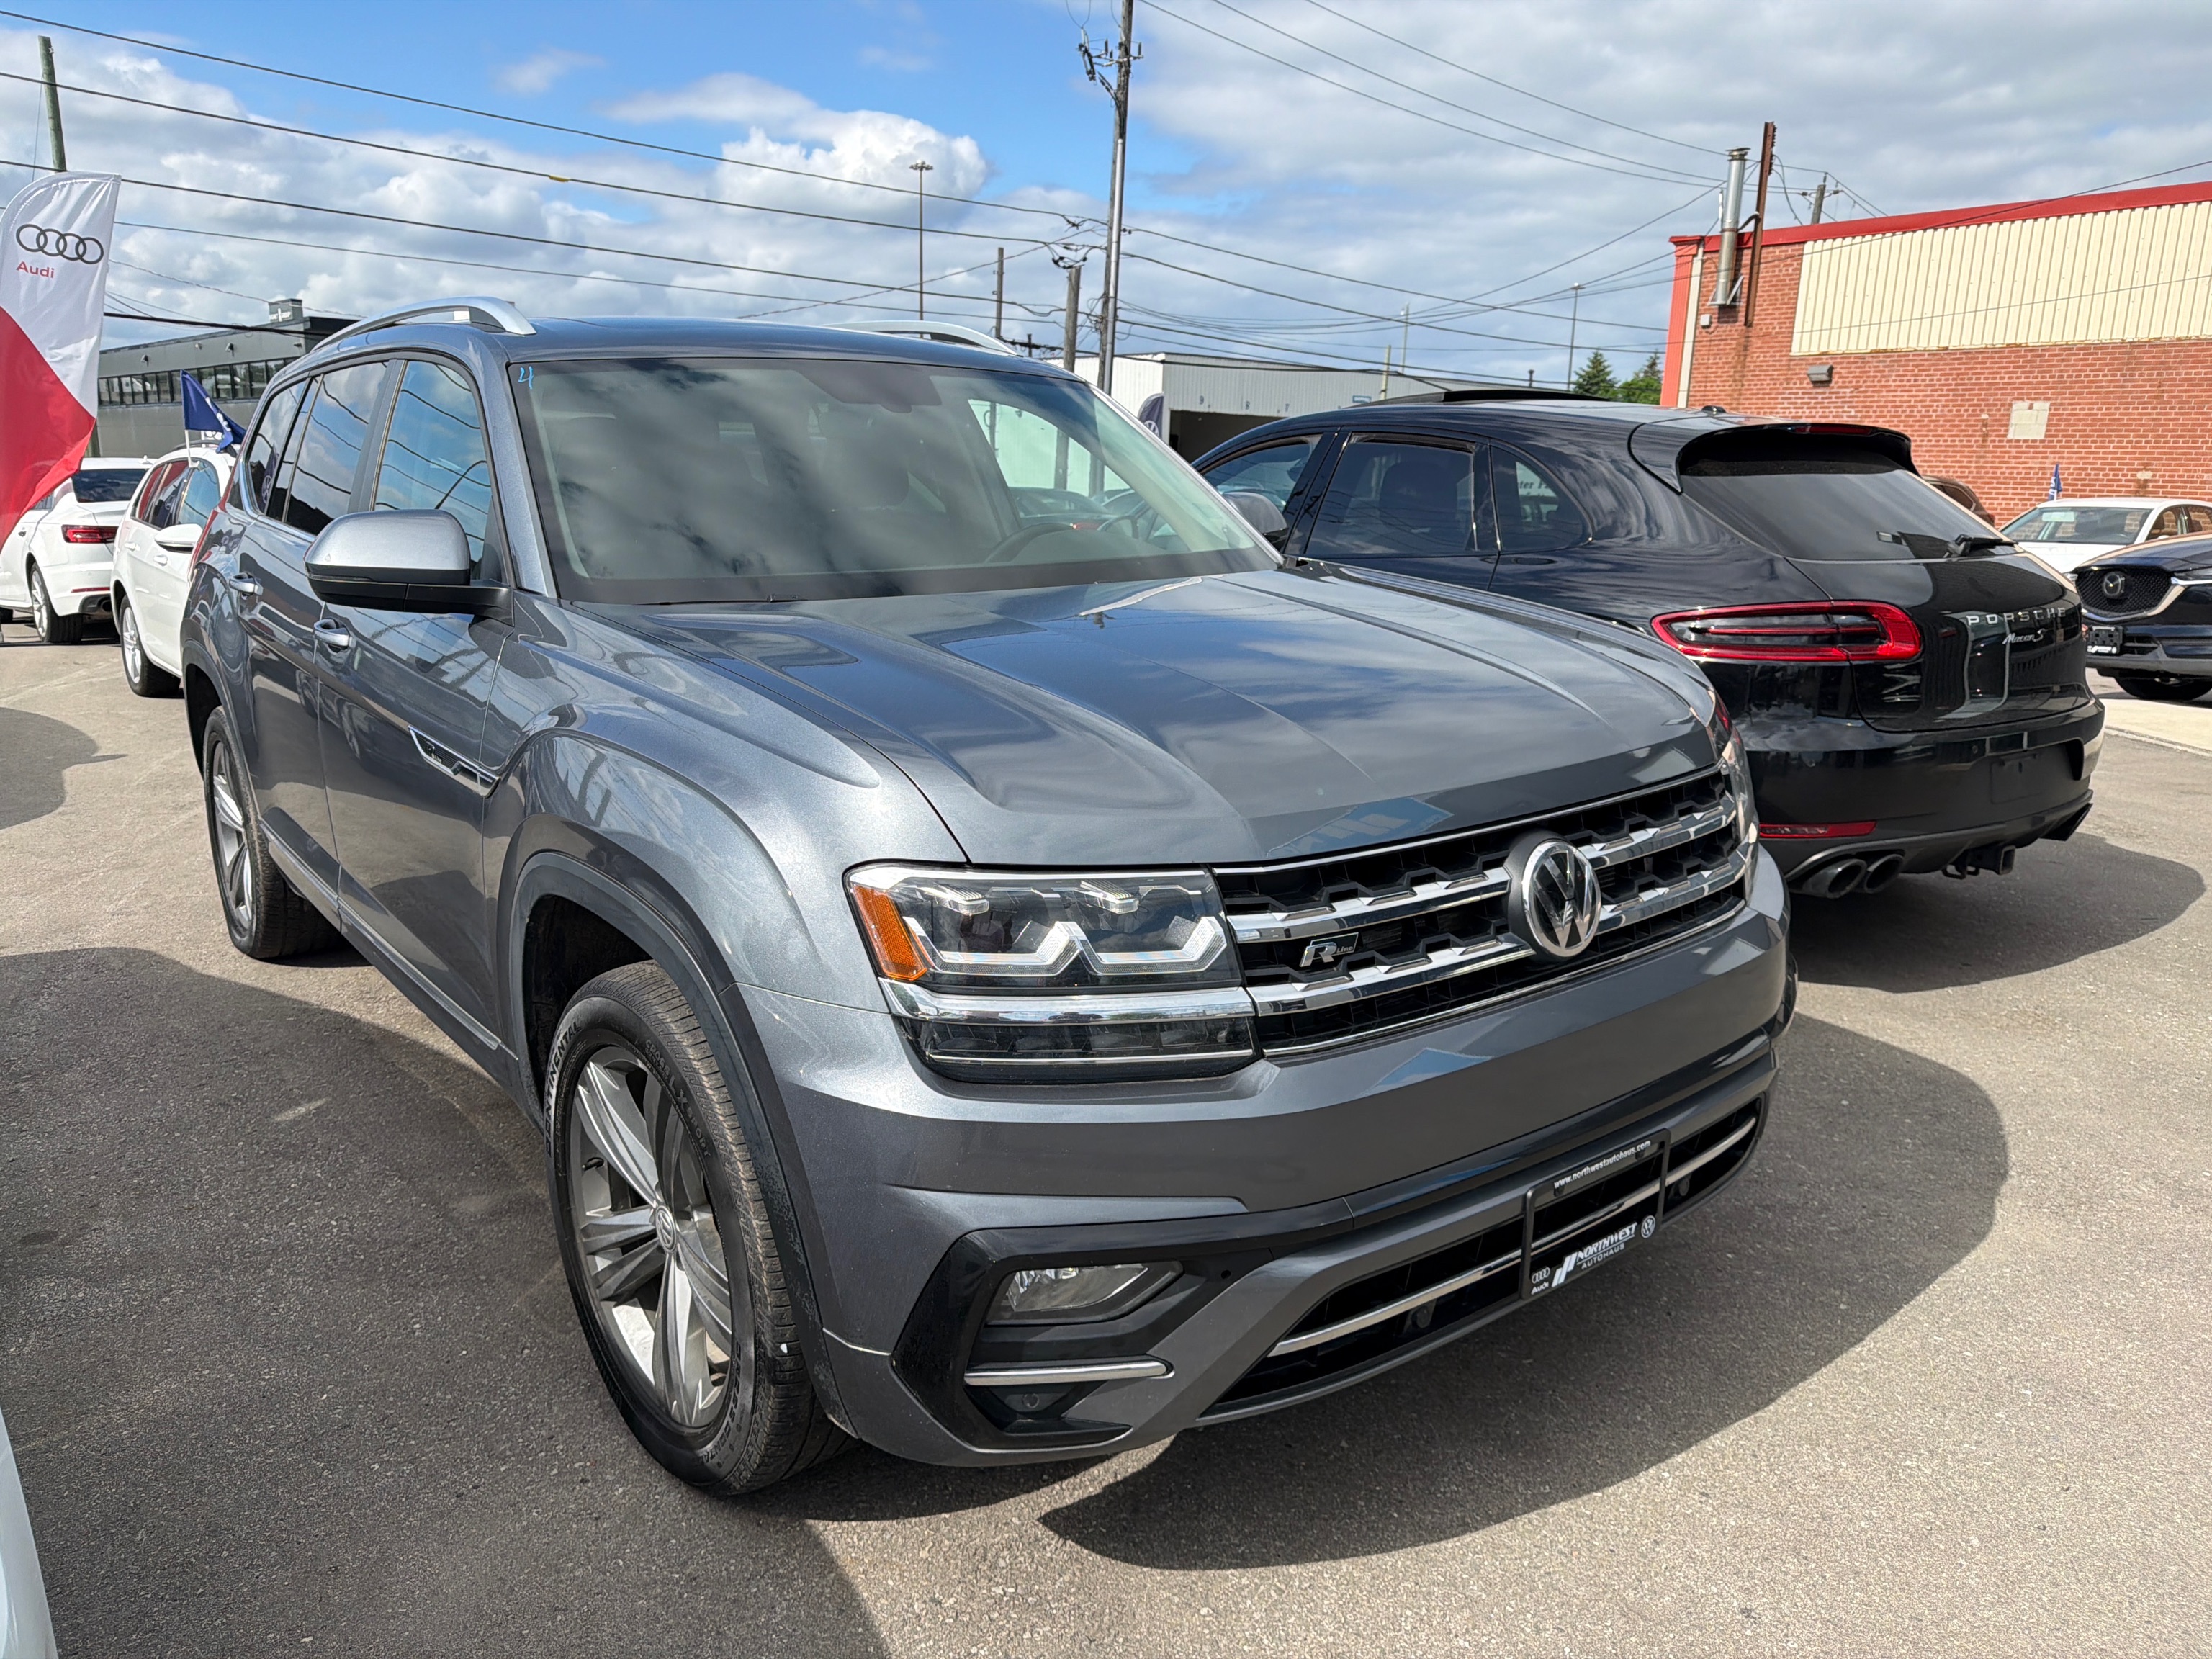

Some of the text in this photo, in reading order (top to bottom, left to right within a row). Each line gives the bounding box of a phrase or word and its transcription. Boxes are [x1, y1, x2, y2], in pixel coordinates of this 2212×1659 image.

[16, 261, 55, 279] Audi
[518, 365, 535, 390] 4
[1966, 607, 2066, 626] PORSCHE
[2002, 628, 2046, 645] Macan S
[1299, 941, 1354, 968] R Line
[645, 1039, 670, 1076] CROSS
[545, 1021, 582, 1158] CONTINENTAL
[669, 1074, 688, 1111] LX
[687, 1107, 711, 1161] SPORT
[1554, 1140, 1651, 1189] www.northwestautohaus.com
[1576, 1222, 1637, 1262] NORTHWEST
[1581, 1241, 1625, 1269] AUTOHAUS
[1531, 1282, 1550, 1295] Audi
